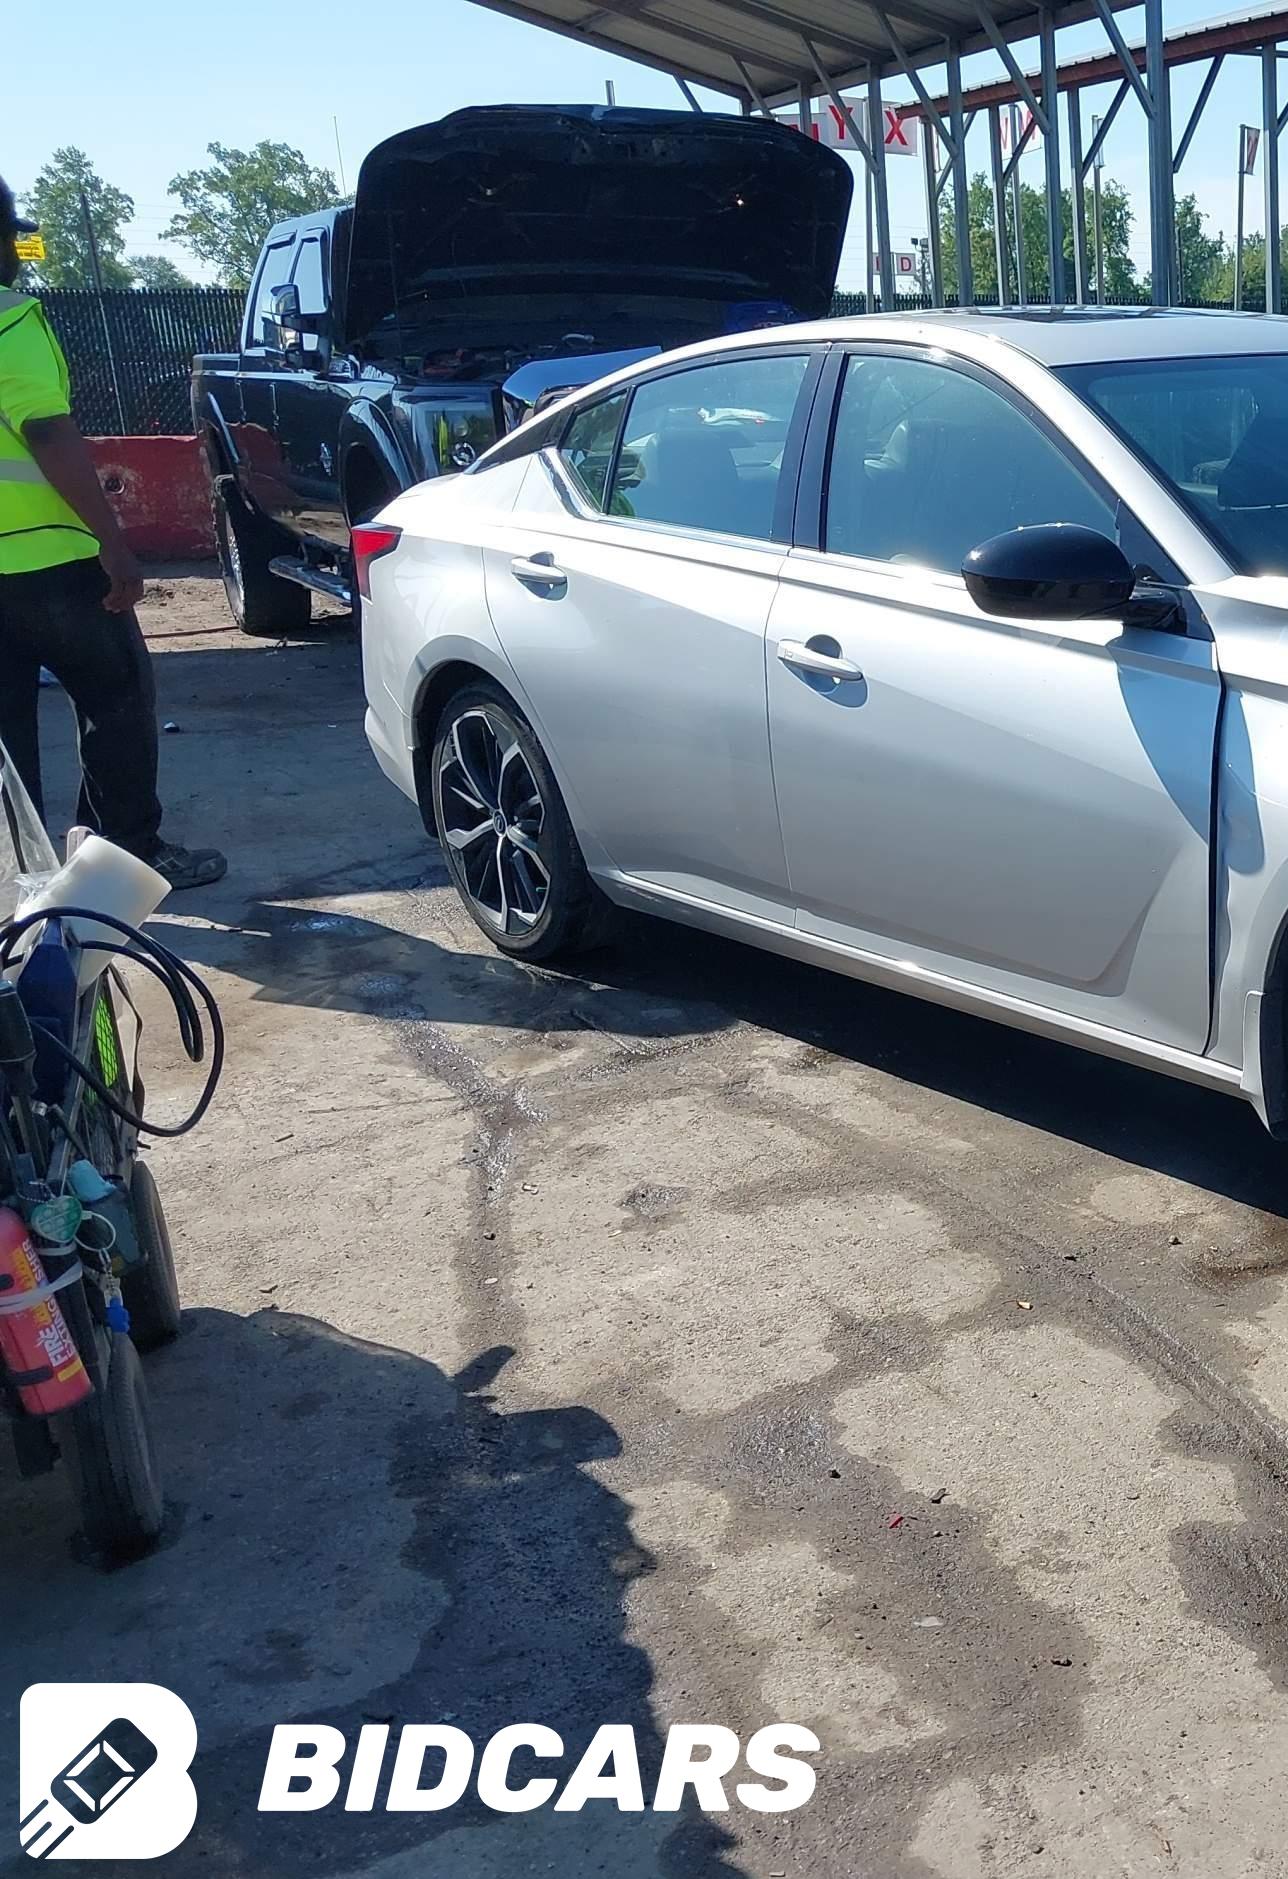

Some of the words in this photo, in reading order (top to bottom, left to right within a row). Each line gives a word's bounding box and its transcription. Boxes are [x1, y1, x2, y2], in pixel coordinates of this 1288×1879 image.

[884, 109, 908, 145] X
[900, 256, 912, 272] D
[22, 1237, 76, 1359] EXTINGSHER
[38, 1323, 68, 1367] FIRE
